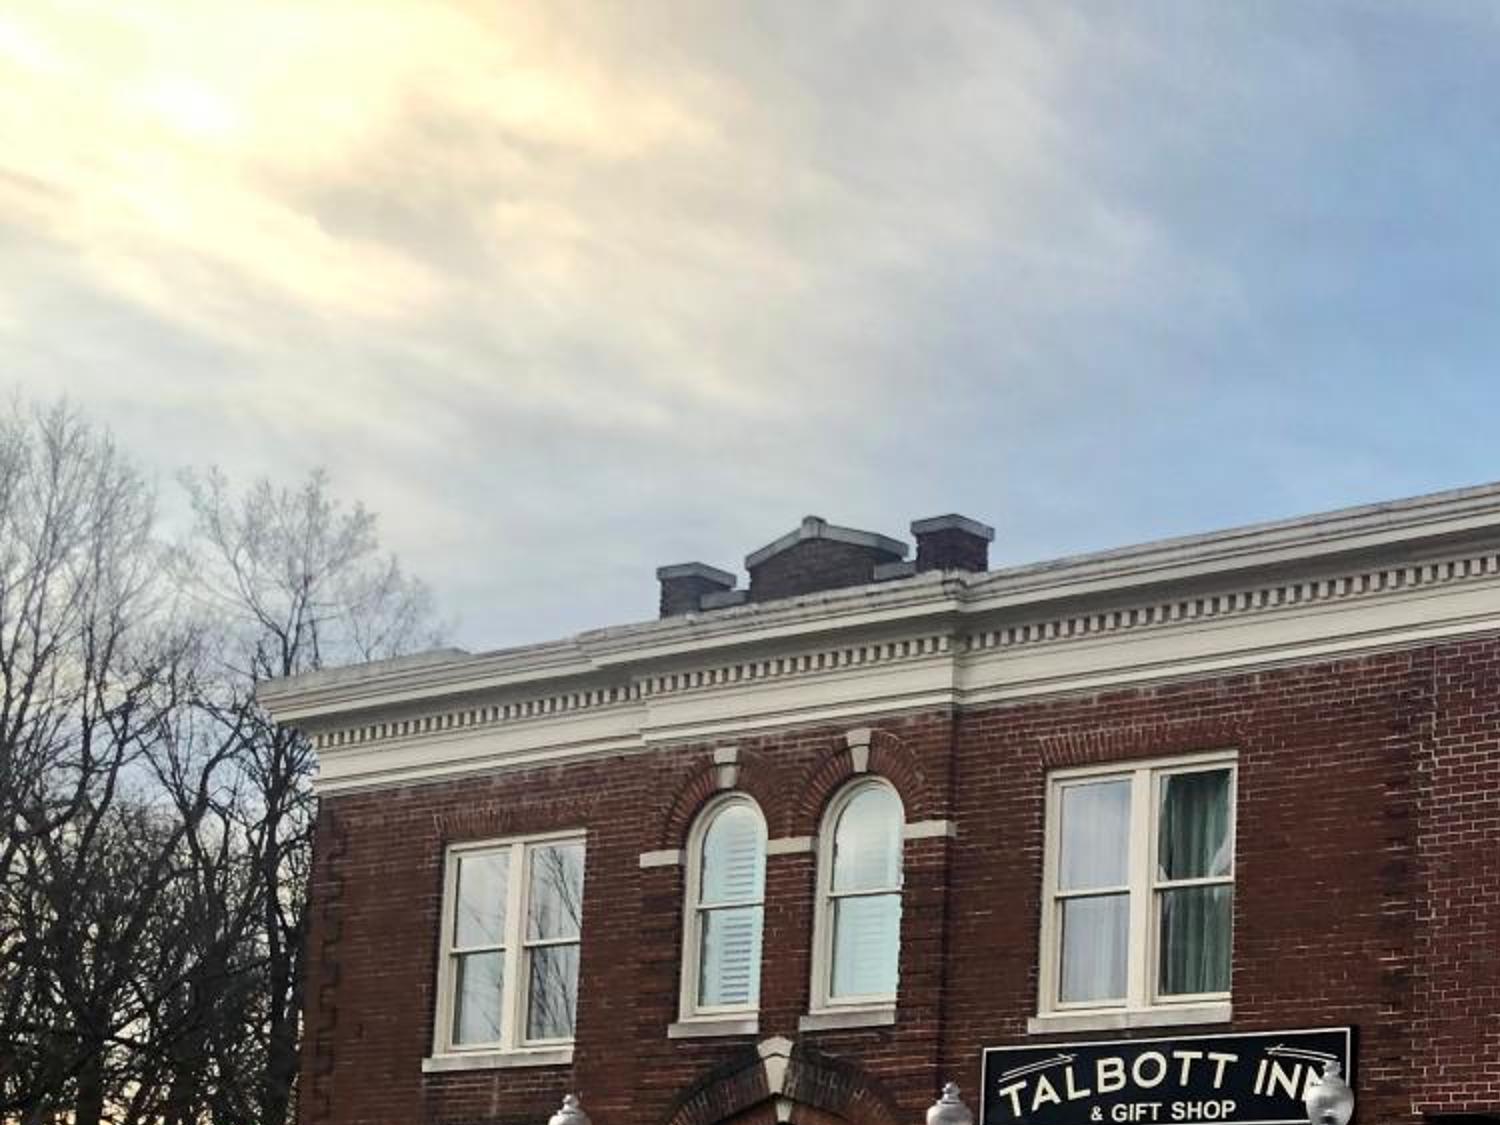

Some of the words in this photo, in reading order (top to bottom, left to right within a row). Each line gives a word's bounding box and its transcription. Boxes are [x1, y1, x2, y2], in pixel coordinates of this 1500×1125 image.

[999, 1051, 1239, 1117] TALBOTT
[1091, 1105, 1103, 1121] &
[1111, 1102, 1162, 1122] GIFT
[1171, 1100, 1237, 1120] SHOP
